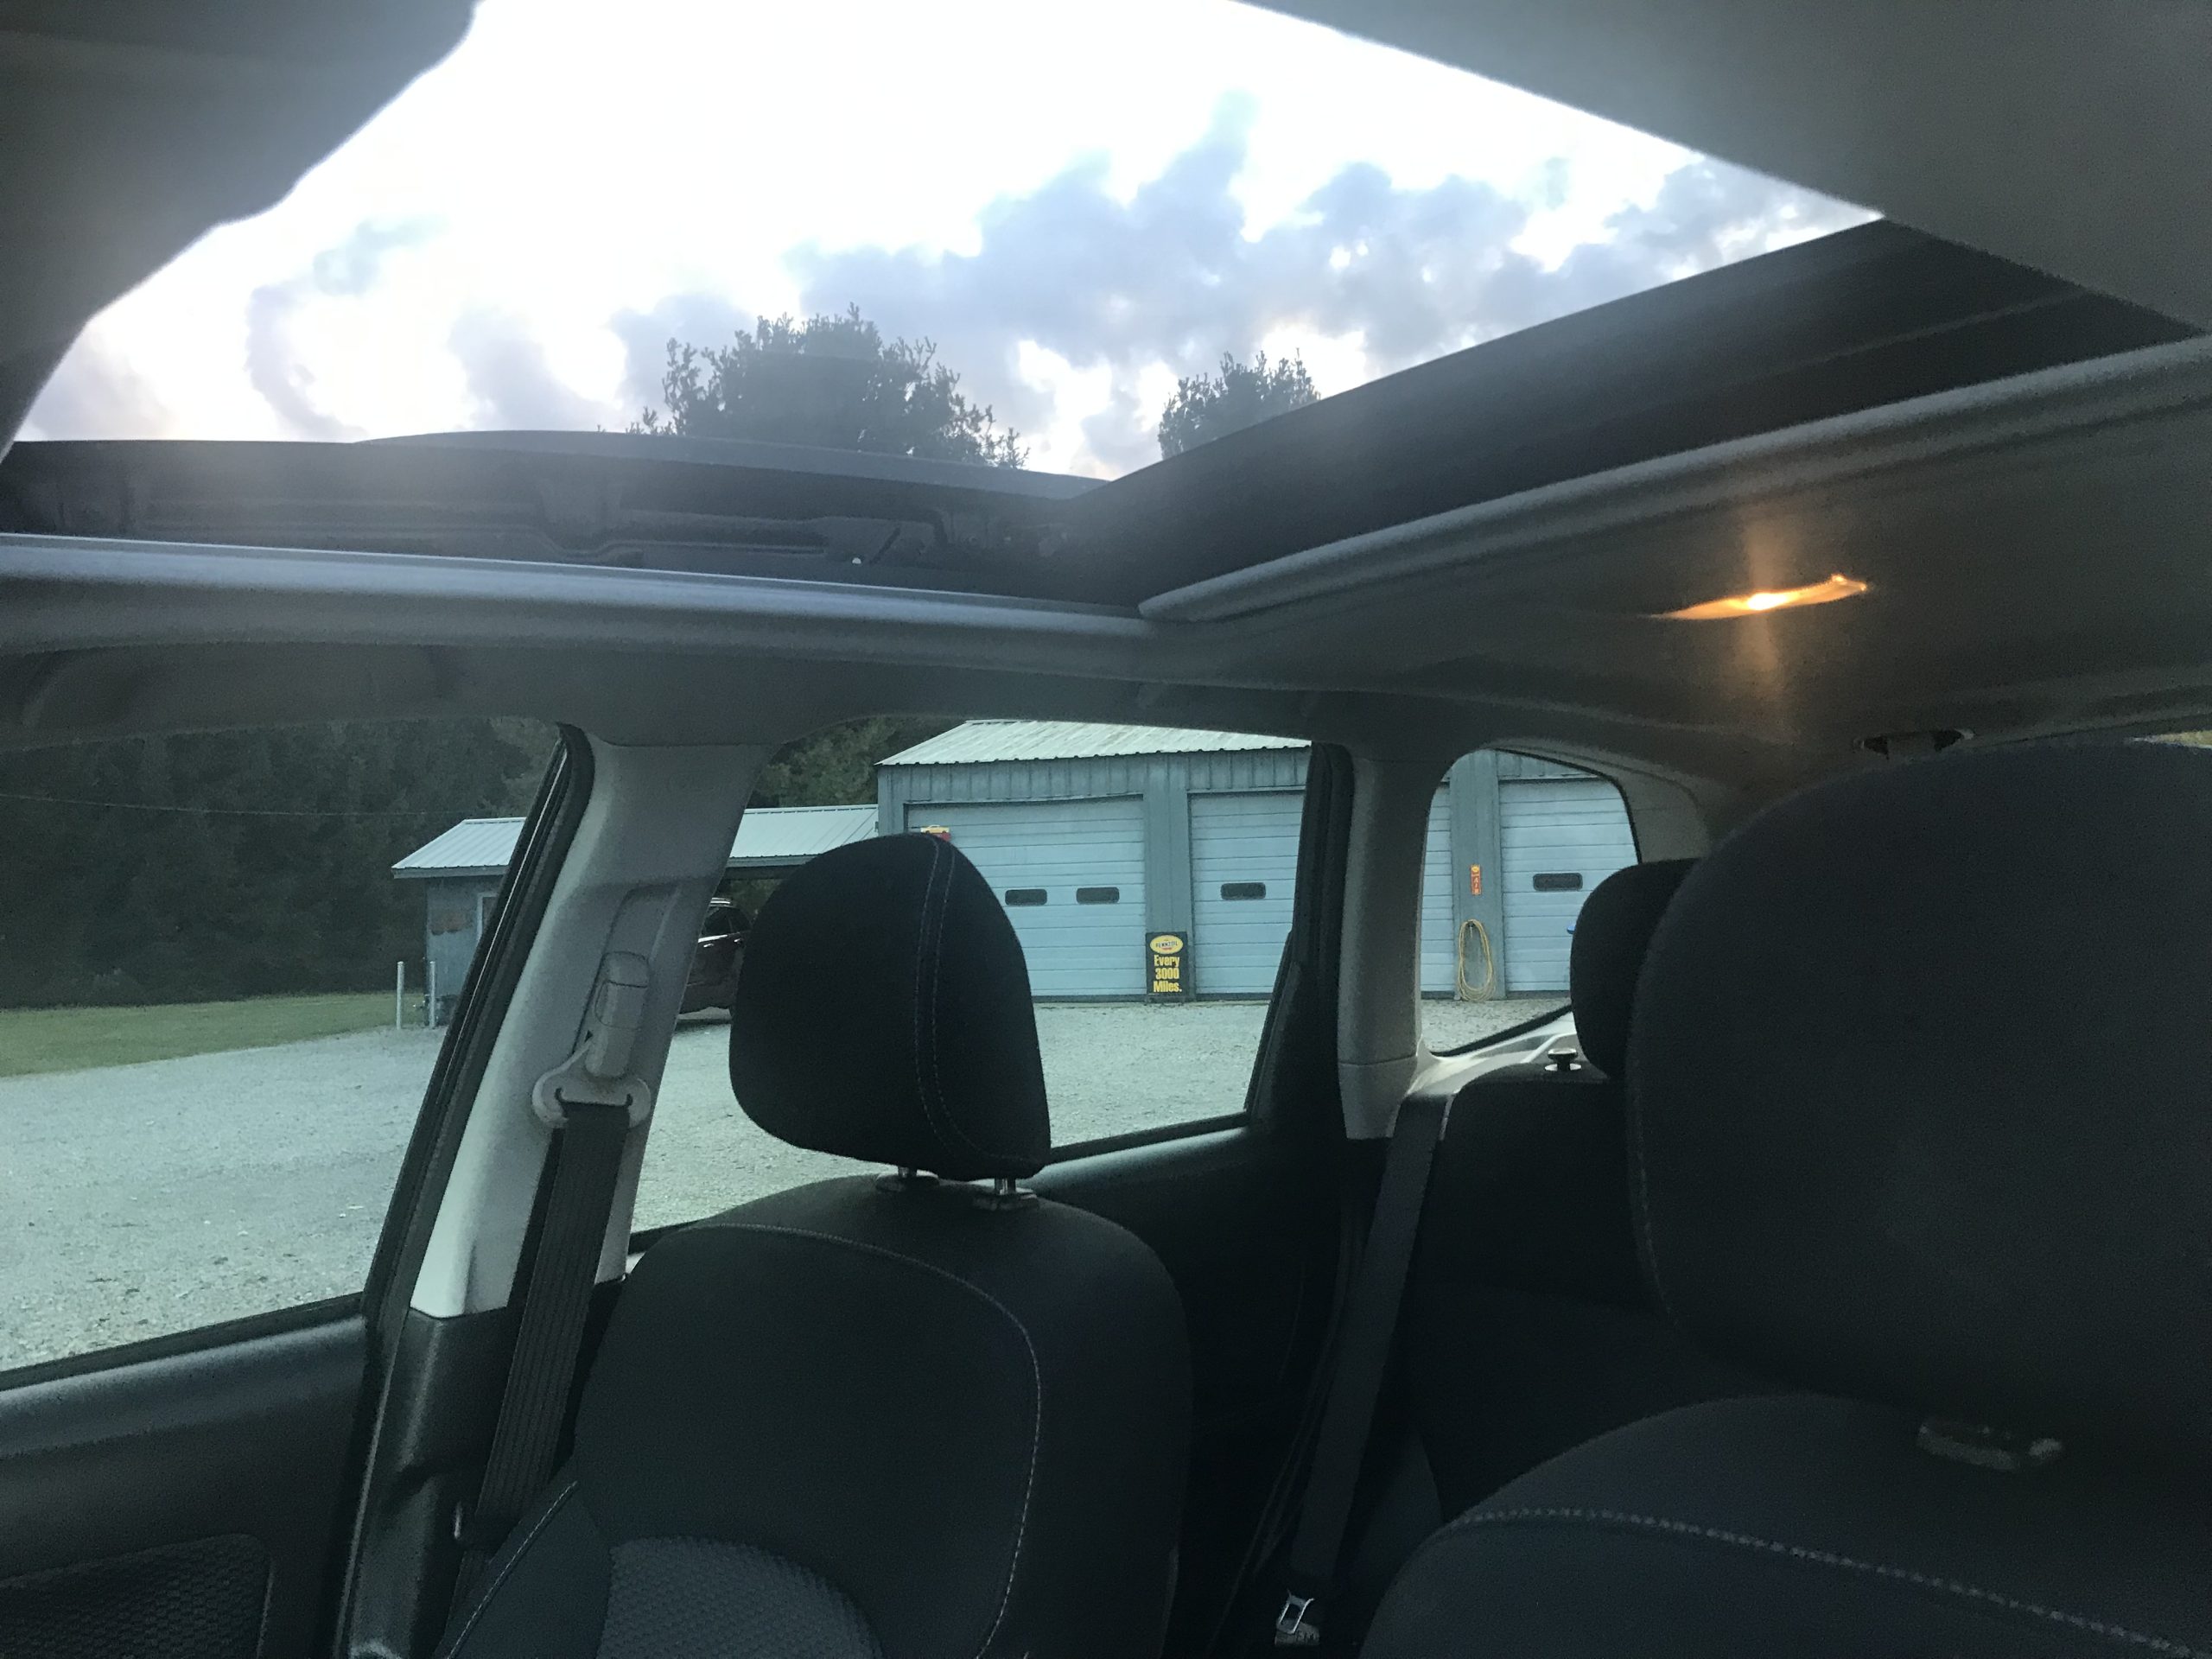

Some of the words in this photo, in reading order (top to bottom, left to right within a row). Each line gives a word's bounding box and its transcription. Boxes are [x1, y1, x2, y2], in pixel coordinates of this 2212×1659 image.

[1154, 954, 1180, 968] Every
[1155, 968, 1179, 980] 3000
[1153, 980, 1182, 993] Miles.
